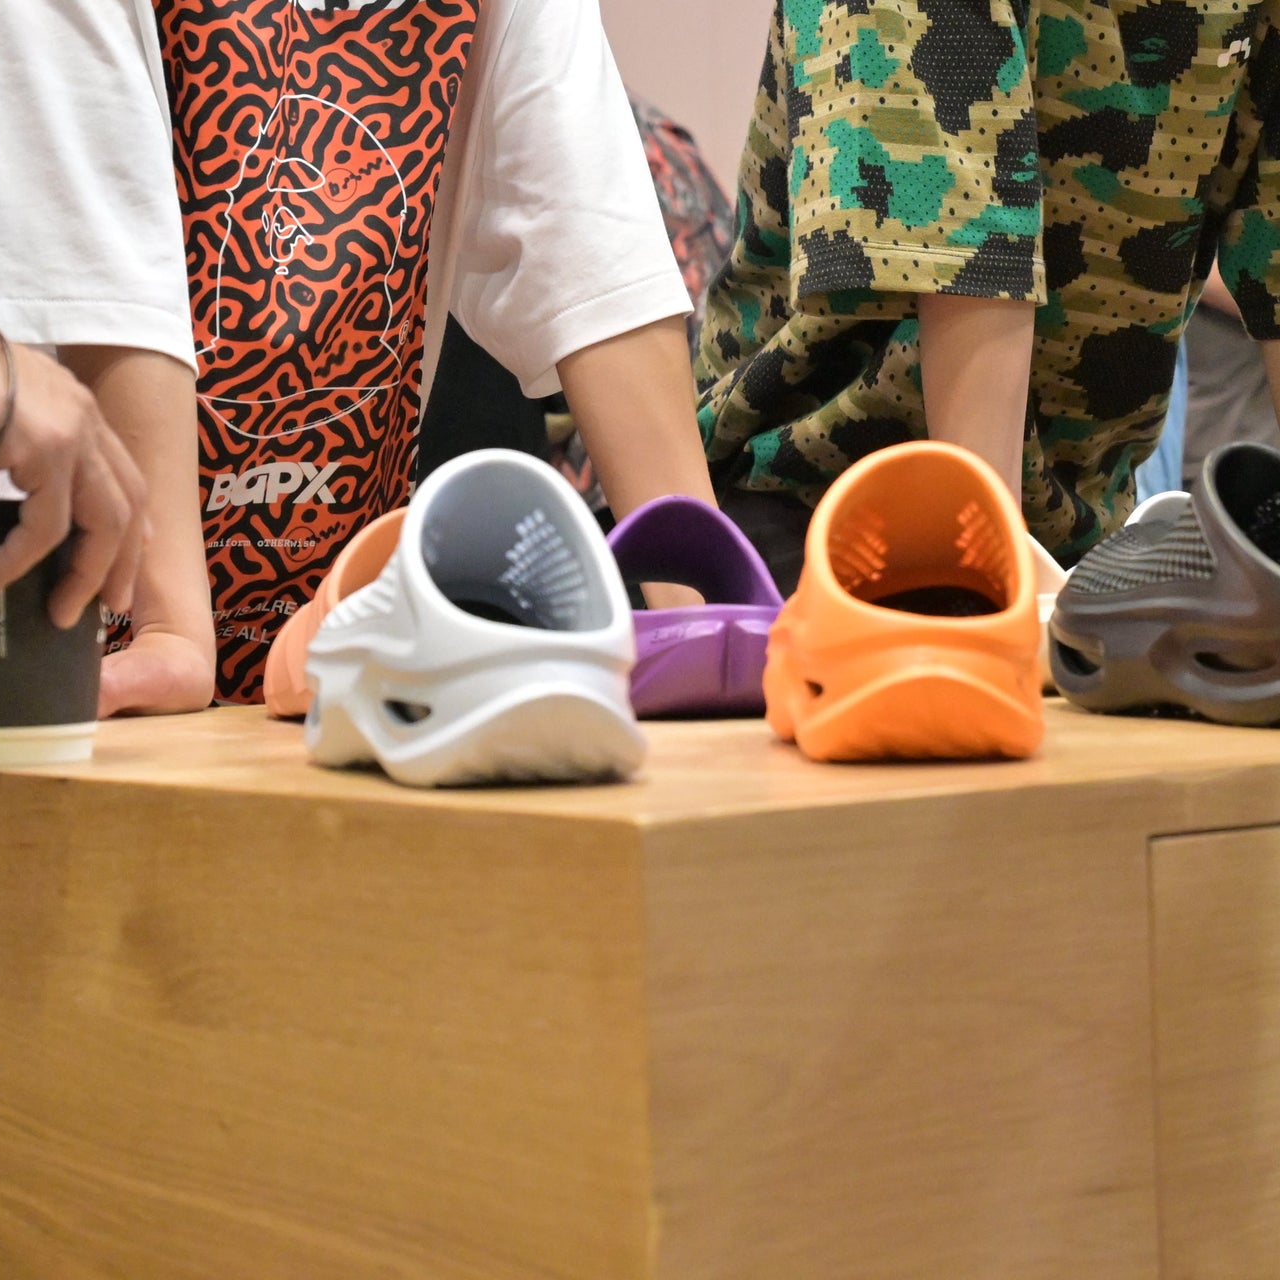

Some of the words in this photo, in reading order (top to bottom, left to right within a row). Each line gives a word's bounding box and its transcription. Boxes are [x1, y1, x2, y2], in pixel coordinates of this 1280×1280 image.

[208, 538, 251, 548] uniform
[257, 538, 316, 548] oTHERwise
[236, 626, 271, 644] ALL
